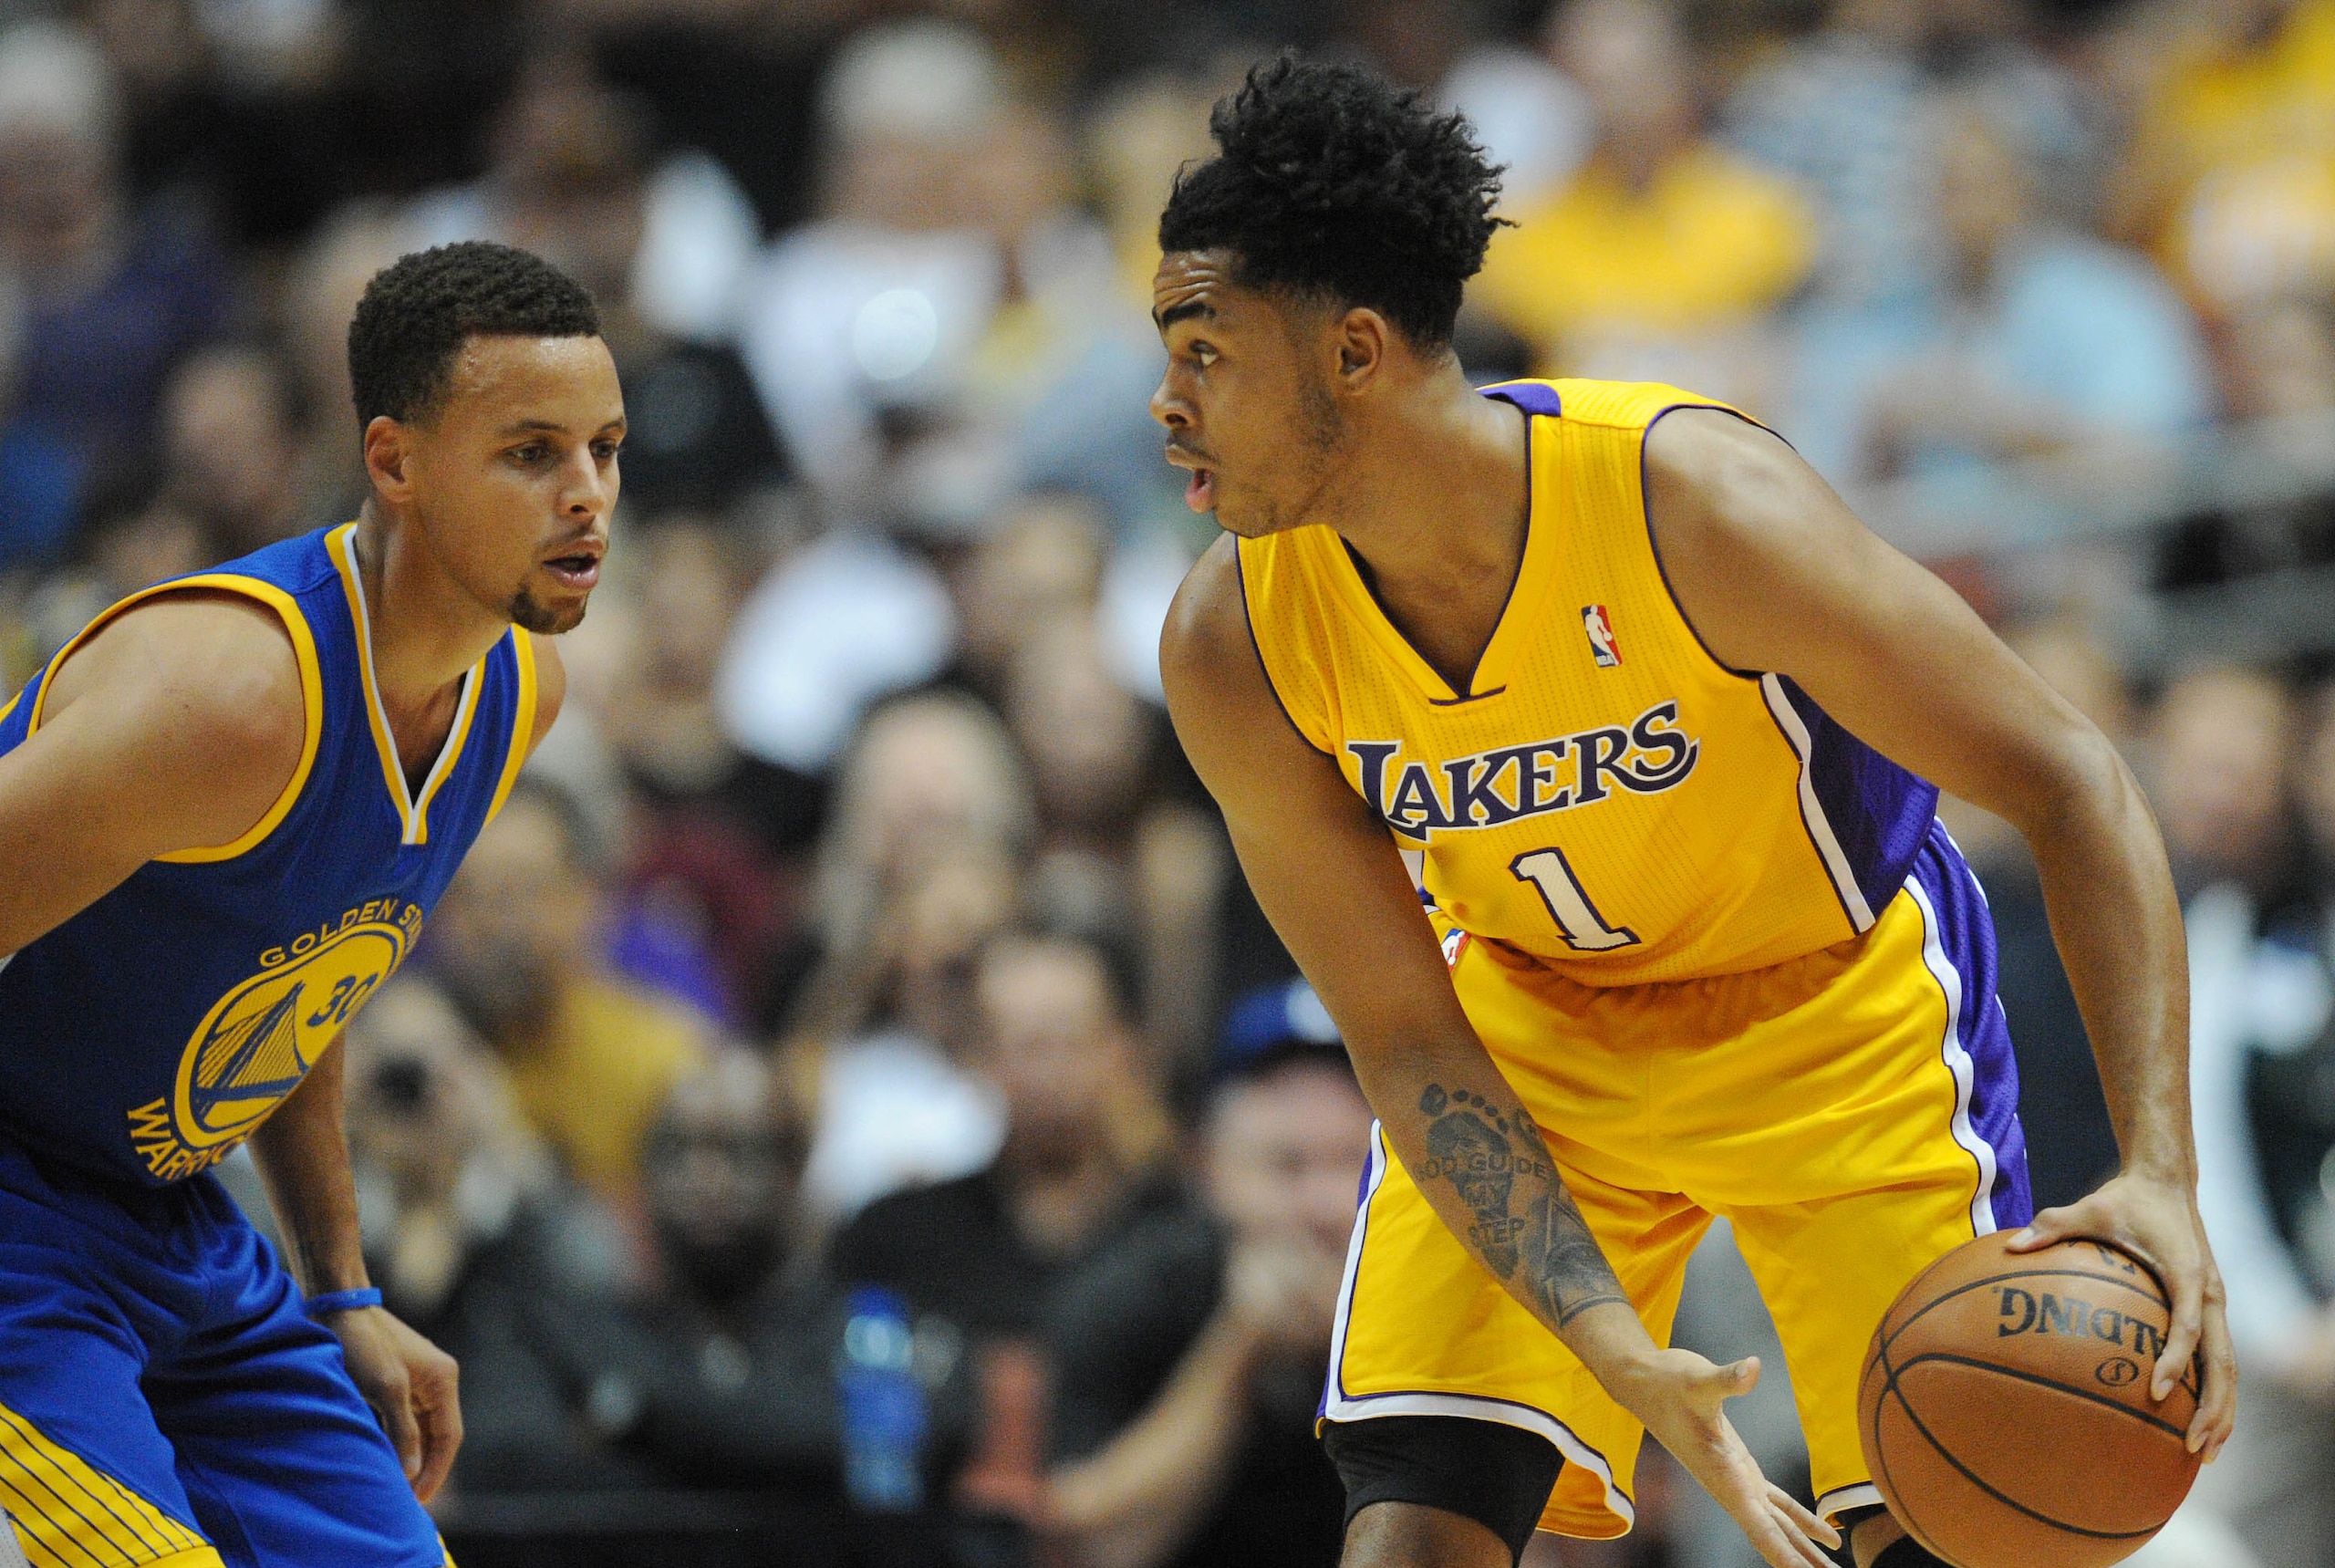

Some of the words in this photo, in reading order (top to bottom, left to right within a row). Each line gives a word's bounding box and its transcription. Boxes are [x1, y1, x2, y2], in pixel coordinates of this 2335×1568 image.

[1346, 700, 1700, 842] LAKERS
[259, 898, 399, 968] GOLDEN
[1508, 846, 1642, 951] 1
[306, 974, 379, 1027] 30
[1468, 1153, 1547, 1179] GUIDE
[1998, 1287, 2168, 1362] ALDING
